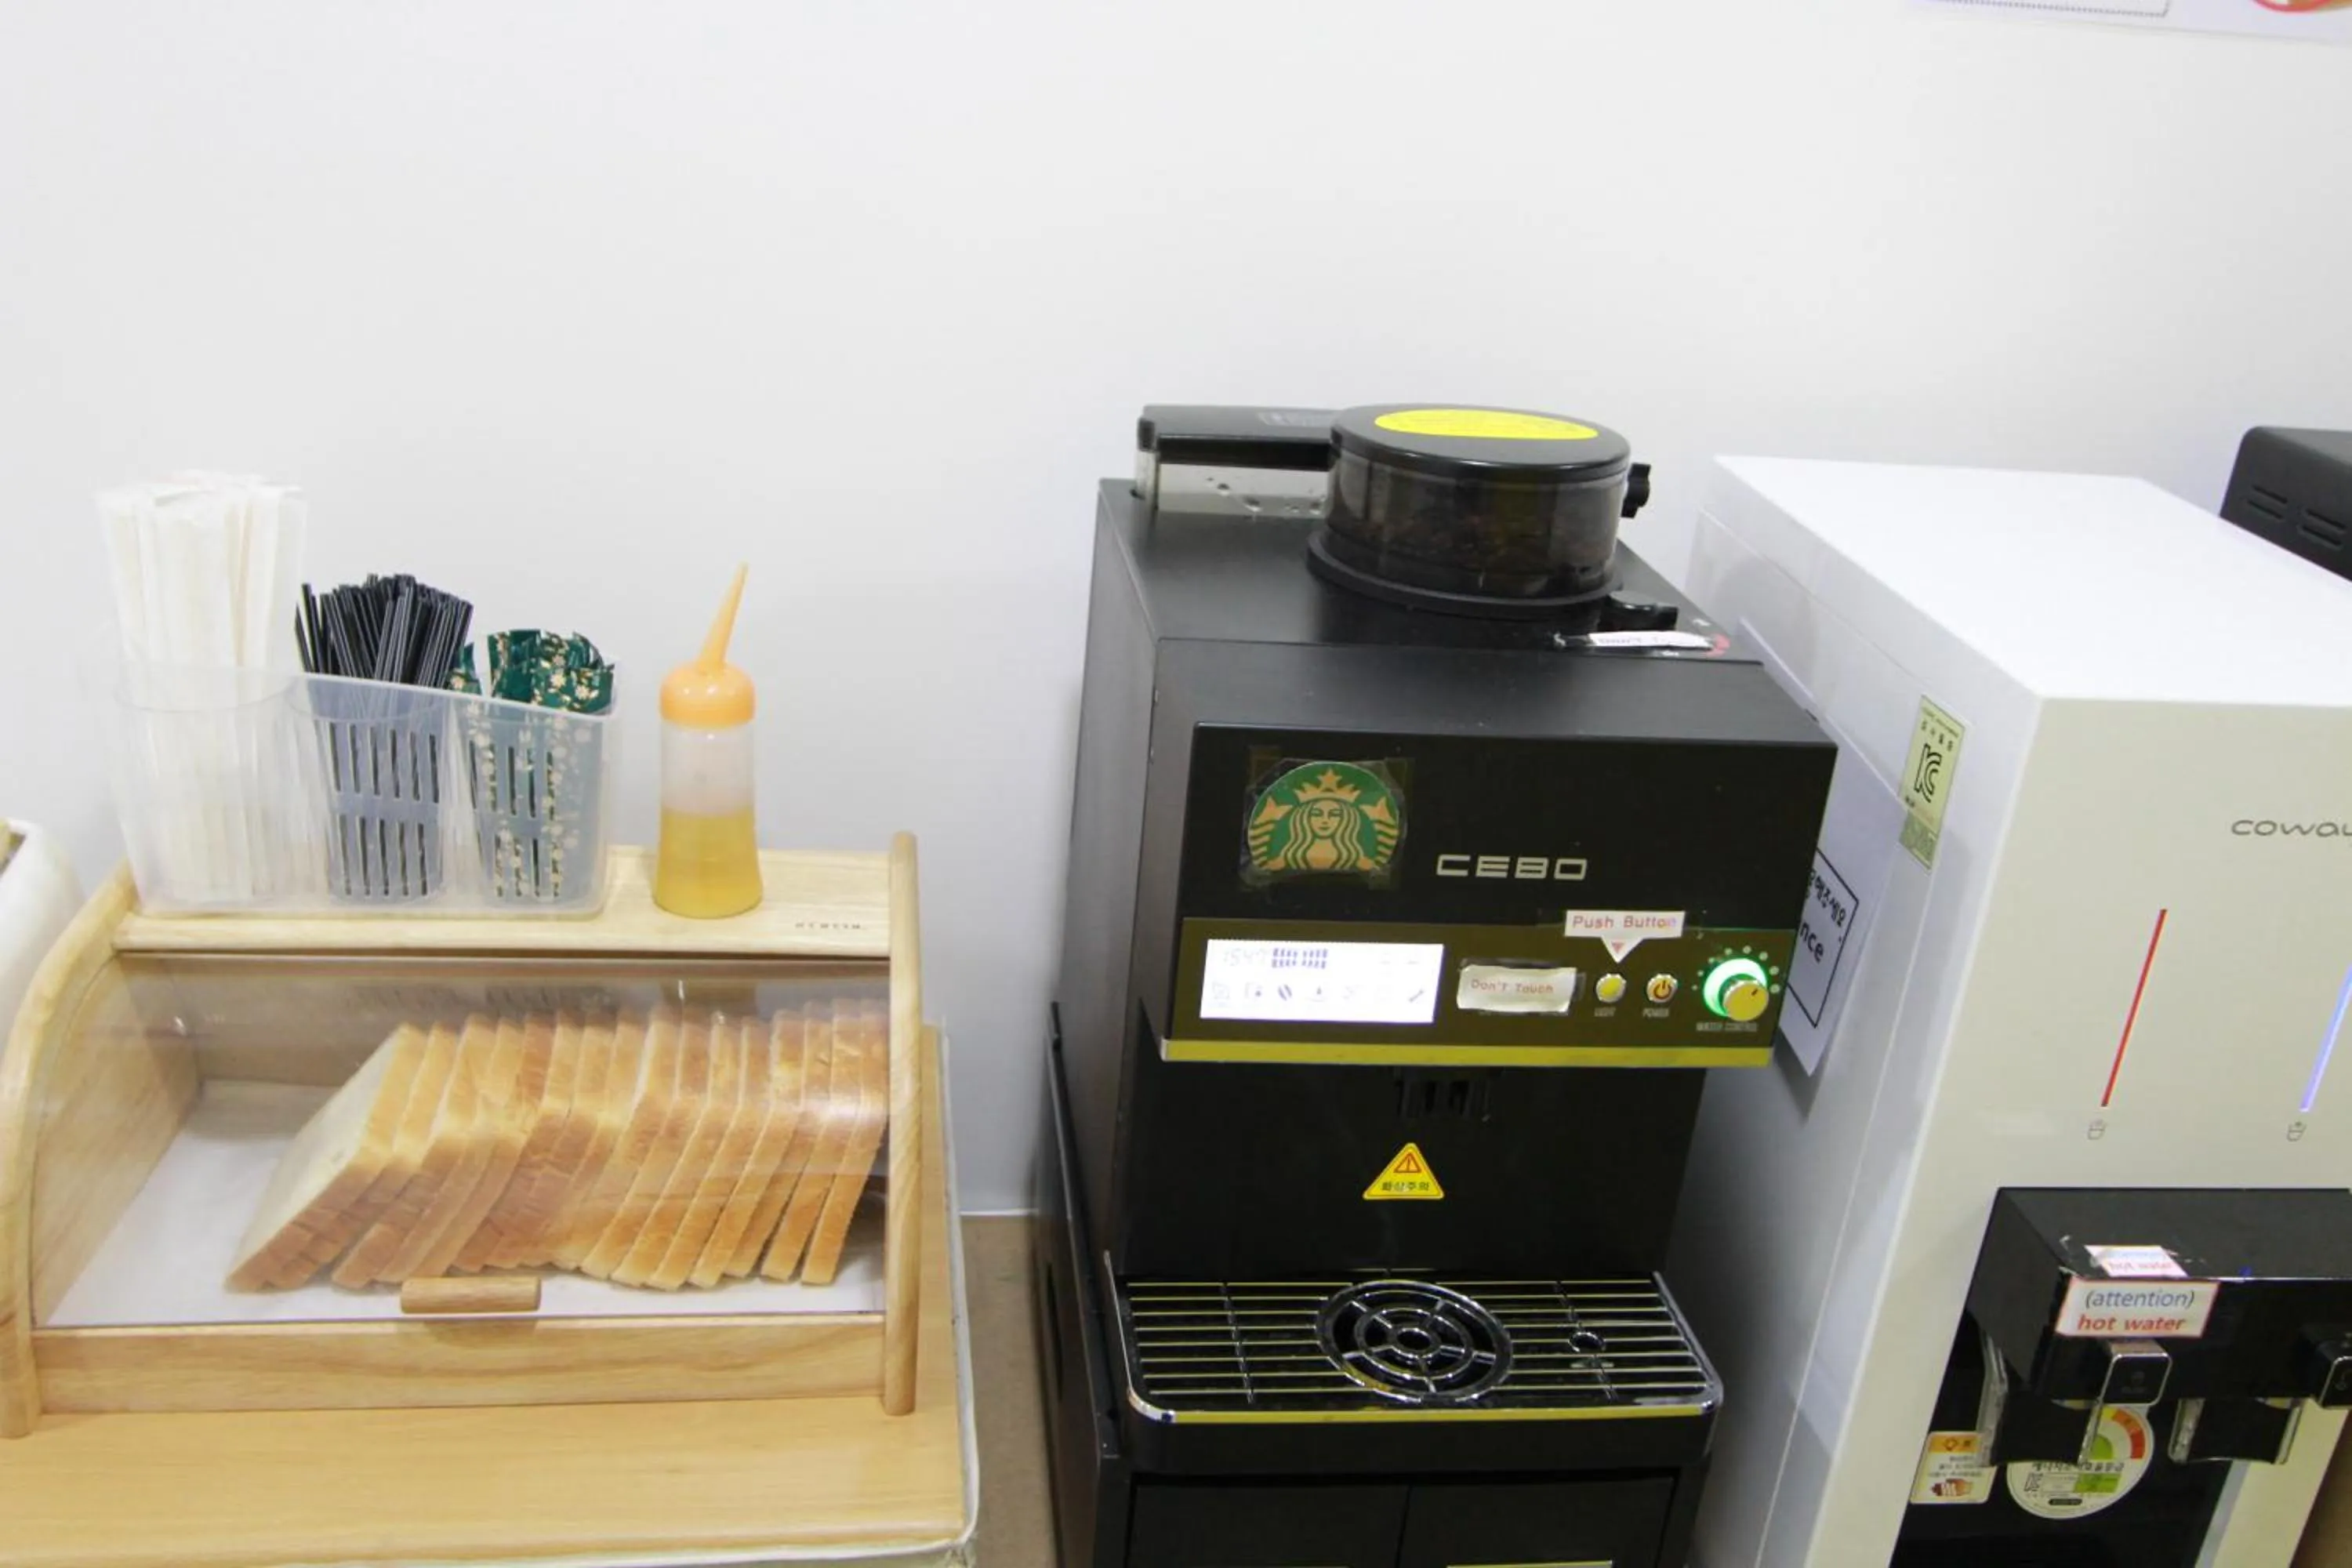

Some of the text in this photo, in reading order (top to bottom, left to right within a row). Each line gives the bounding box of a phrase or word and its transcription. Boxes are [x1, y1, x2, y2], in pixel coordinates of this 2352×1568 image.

[1436, 854, 1588, 880] CEBO
[1572, 915, 1677, 929] Push Button
[1515, 982, 1555, 994] Touch
[2085, 1288, 2195, 1309] (attention)
[2078, 1313, 2187, 1331] hot water
